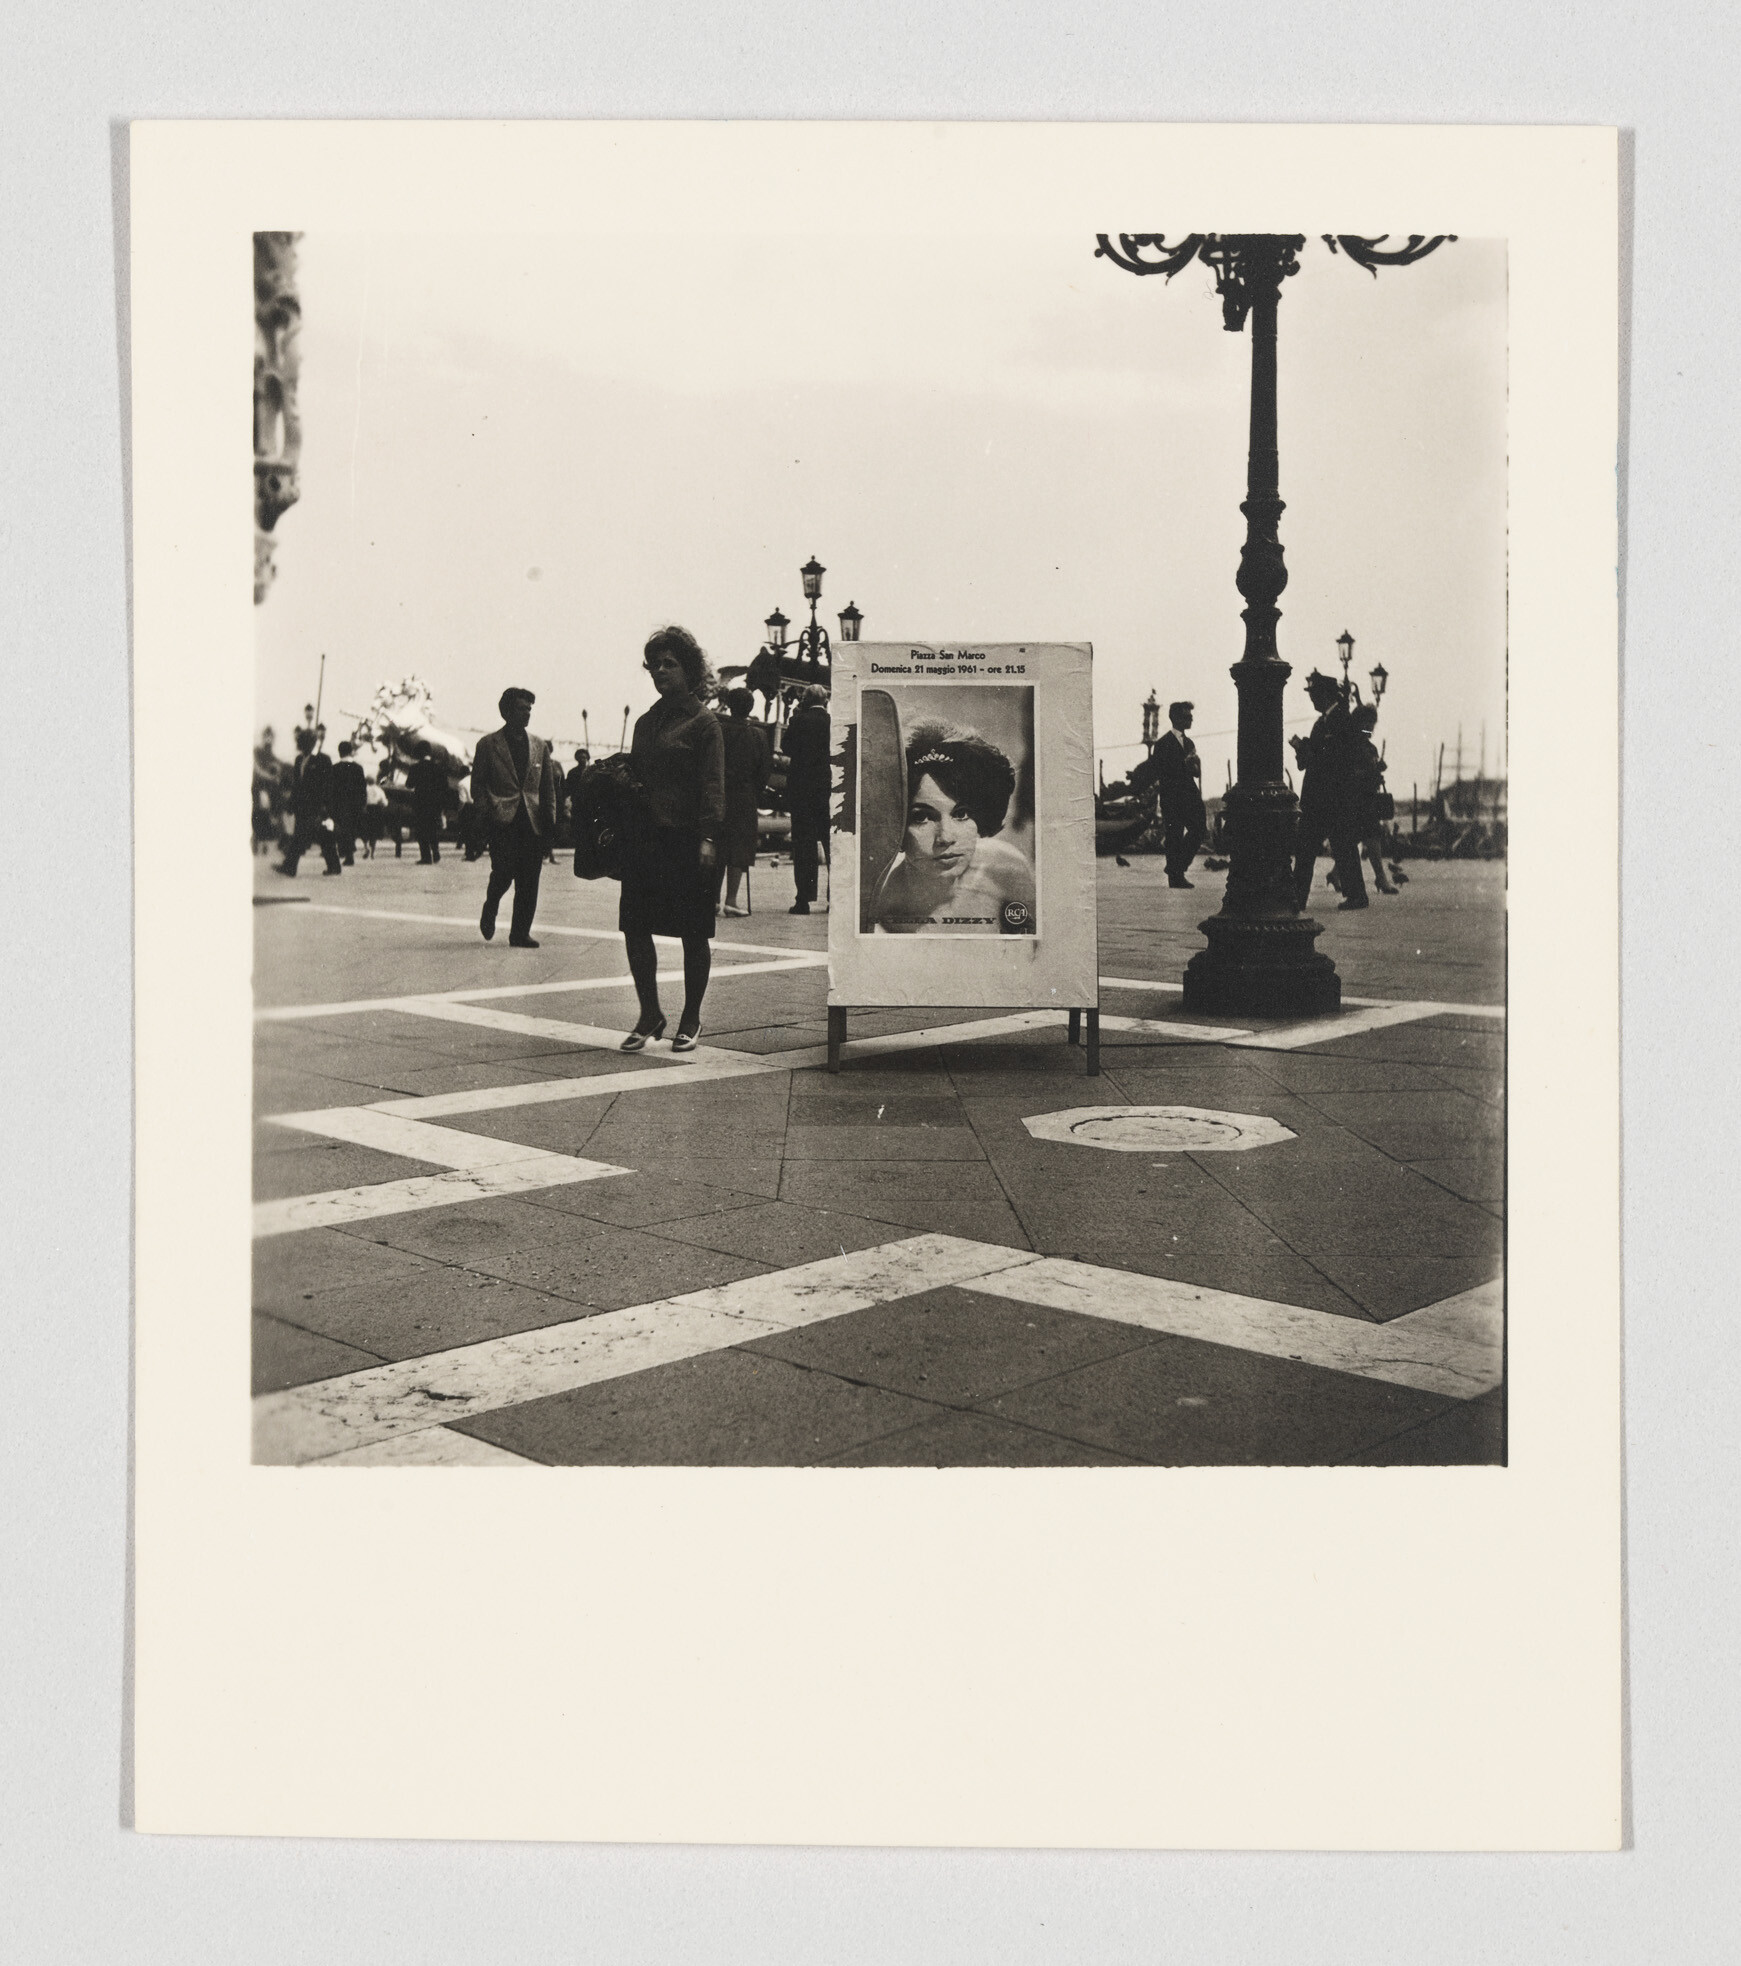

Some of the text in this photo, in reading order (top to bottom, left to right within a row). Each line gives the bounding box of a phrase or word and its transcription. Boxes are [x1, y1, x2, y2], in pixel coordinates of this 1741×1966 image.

[910, 650, 986, 660] Piazza San Marco
[871, 663, 912, 674] Domenica
[914, 665, 924, 673] 21
[926, 664, 956, 675] maggio
[957, 665, 977, 673] 1961
[987, 666, 1002, 674] ore
[1005, 665, 1026, 674] 21.15
[1007, 908, 1027, 920] RCA
[942, 917, 997, 925] DIZZY
